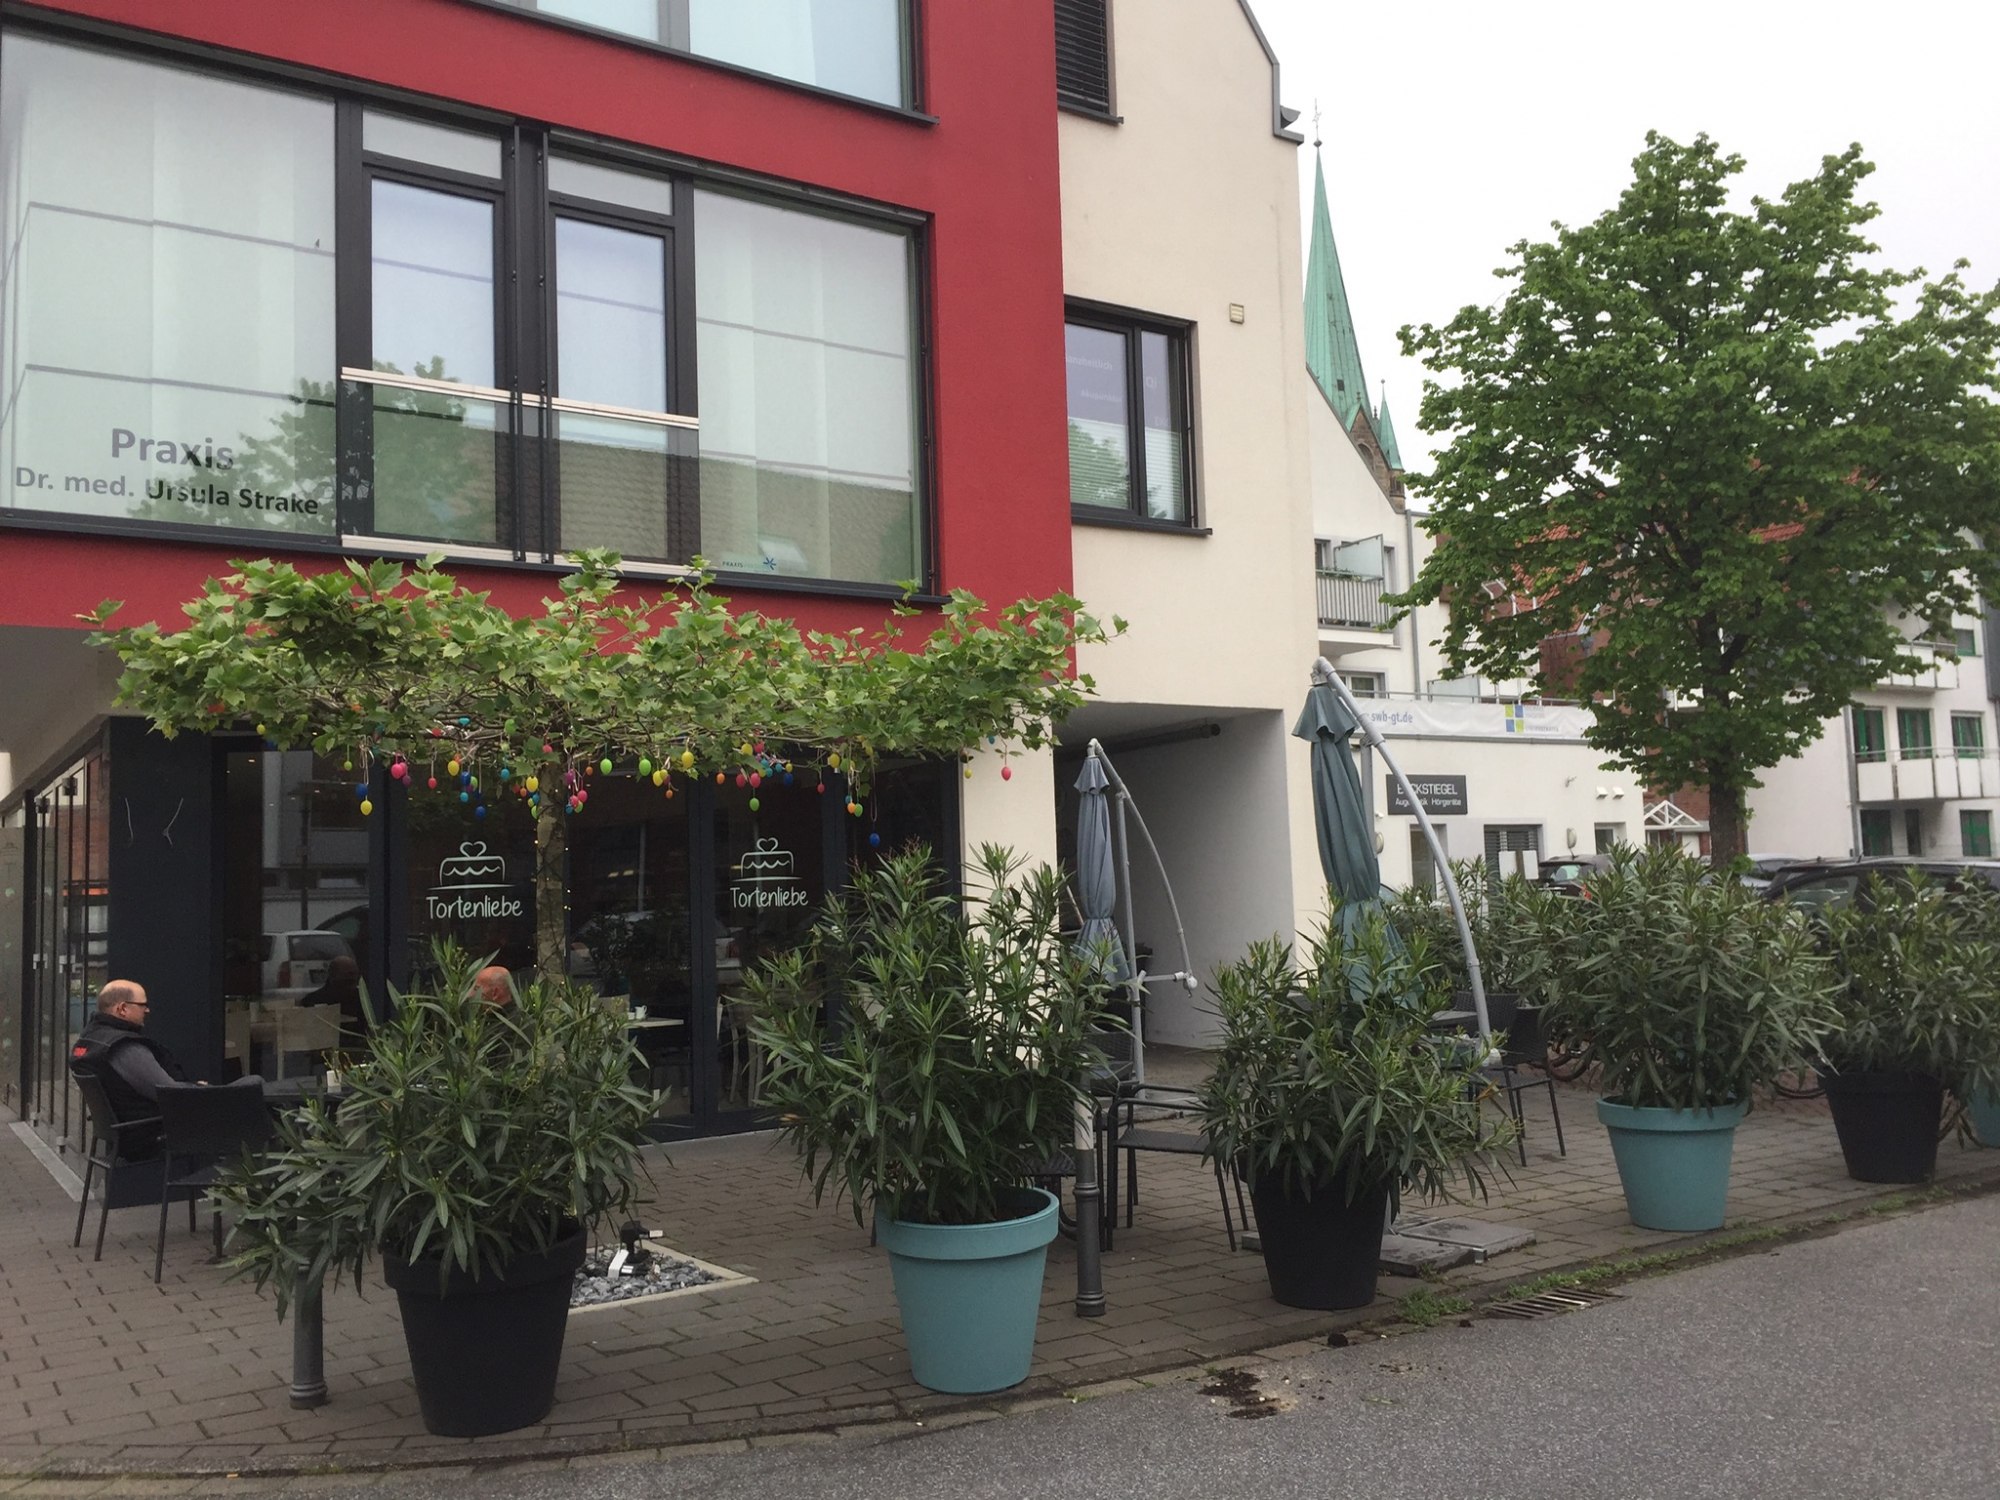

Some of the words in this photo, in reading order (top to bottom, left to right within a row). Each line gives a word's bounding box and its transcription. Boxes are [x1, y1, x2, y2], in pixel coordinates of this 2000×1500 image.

[1066, 355, 1113, 371] anzheitlich
[111, 428, 234, 470] Praxis
[15, 467, 54, 490] Dr.
[64, 475, 135, 497] med.
[146, 479, 230, 506] Ursula
[238, 488, 319, 515] Strake
[1397, 784, 1458, 795] BCKSTIEGEL
[426, 895, 523, 919] Tortenliebe
[731, 886, 809, 909] Tortenliebe
